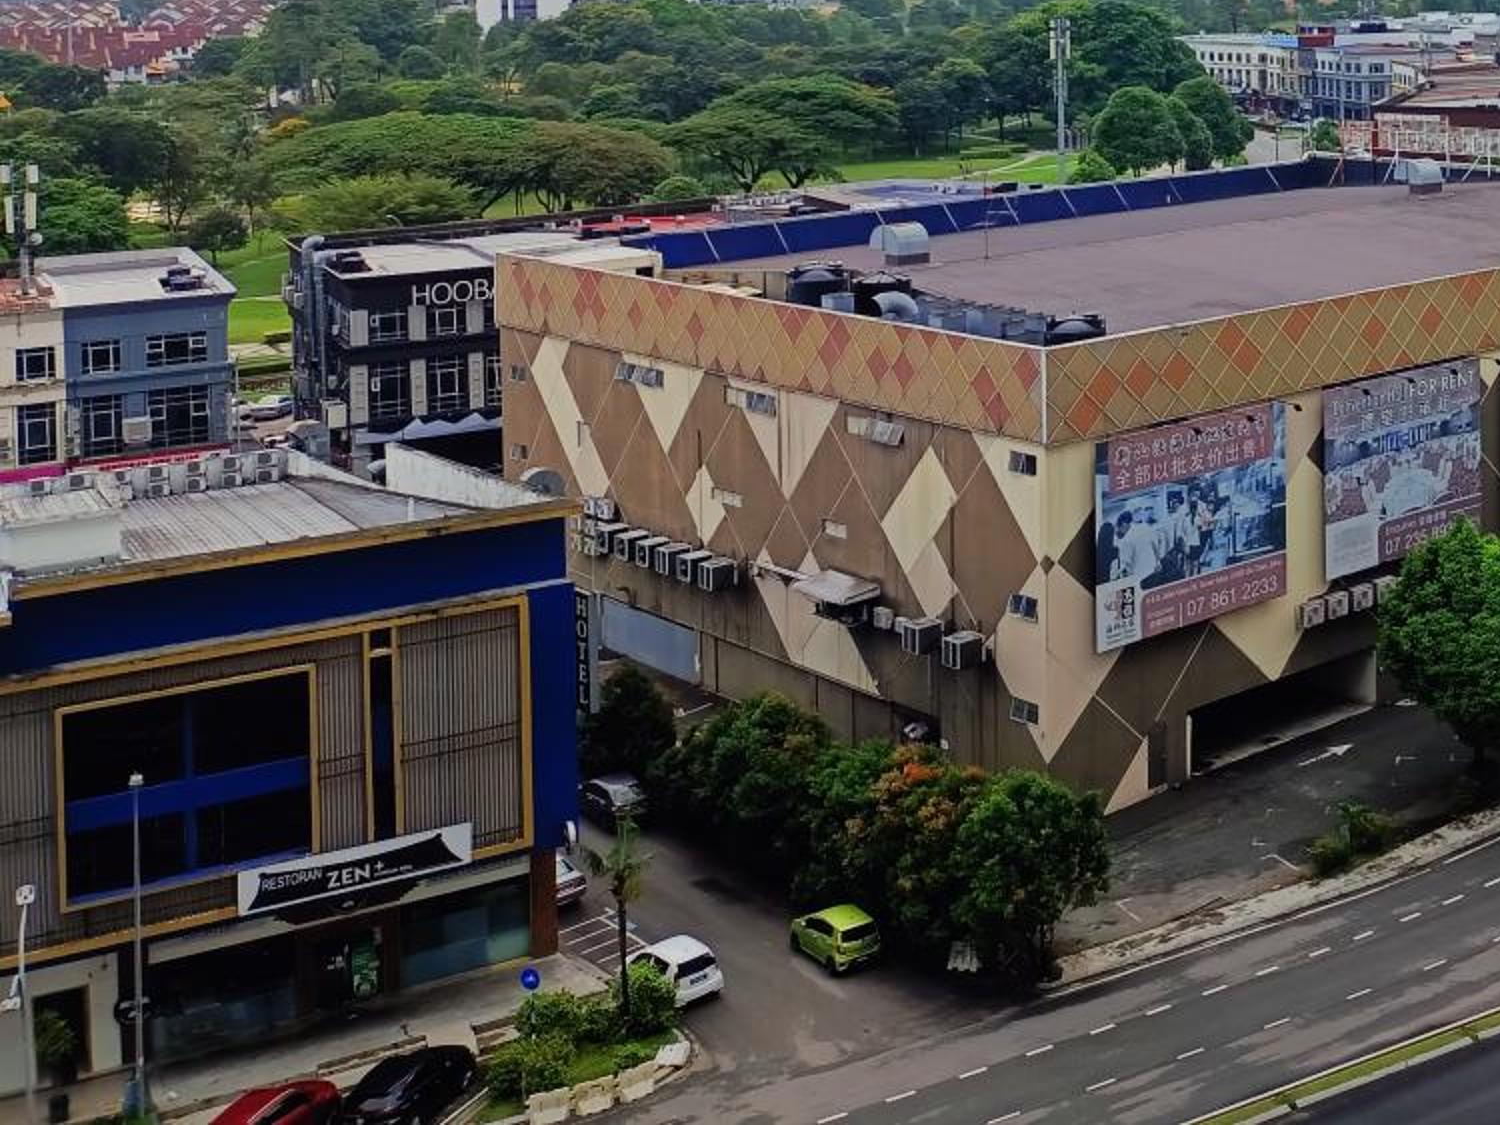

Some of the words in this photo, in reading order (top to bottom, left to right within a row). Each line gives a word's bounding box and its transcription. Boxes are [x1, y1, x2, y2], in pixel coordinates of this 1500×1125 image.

[1408, 379, 1437, 398] FOR
[1441, 370, 1473, 392] RENT
[1385, 538, 1400, 555] 07
[1186, 596, 1205, 617] 07
[1211, 586, 1237, 610] 861
[1241, 575, 1278, 601] 2233
[576, 595, 589, 705] HOTEL
[261, 868, 323, 892] RESTORAN
